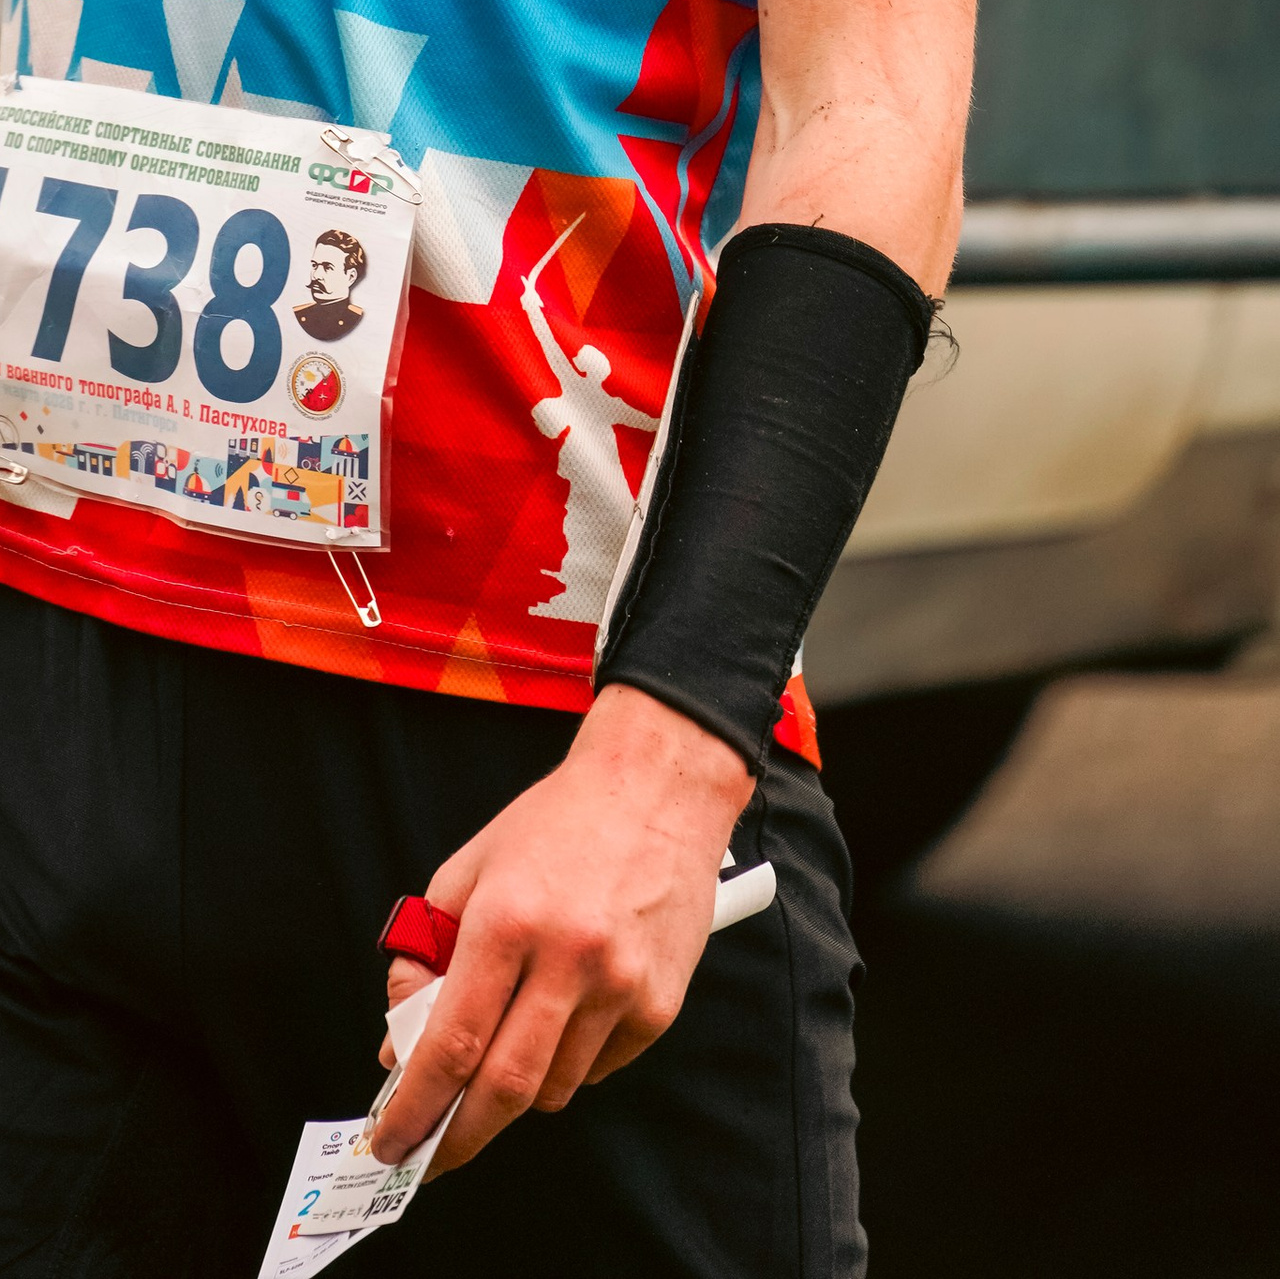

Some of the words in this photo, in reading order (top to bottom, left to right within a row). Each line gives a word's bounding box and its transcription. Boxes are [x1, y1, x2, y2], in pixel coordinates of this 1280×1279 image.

[4, 131, 24, 149] ПО
[26, 135, 127, 168] СПОРТИВНОМУ
[130, 154, 260, 192] ОРИЕНТИРОВАНИЮ
[95, 121, 192, 154] СПОРТИВНЫЕ
[196, 140, 302, 173] СОРЕВНОВАНИЯ
[342, 196, 388, 210] СПОРТИВНОГО
[360, 206, 386, 215] РОССИИ
[6, 364, 73, 392] военного
[78, 379, 161, 410] топографа
[166, 394, 178, 414] А.
[183, 399, 193, 419] В.
[199, 404, 287, 438] Пастухова
[322, 1142, 343, 1150] Спорт
[362, 1191, 407, 1222] БЛОК
